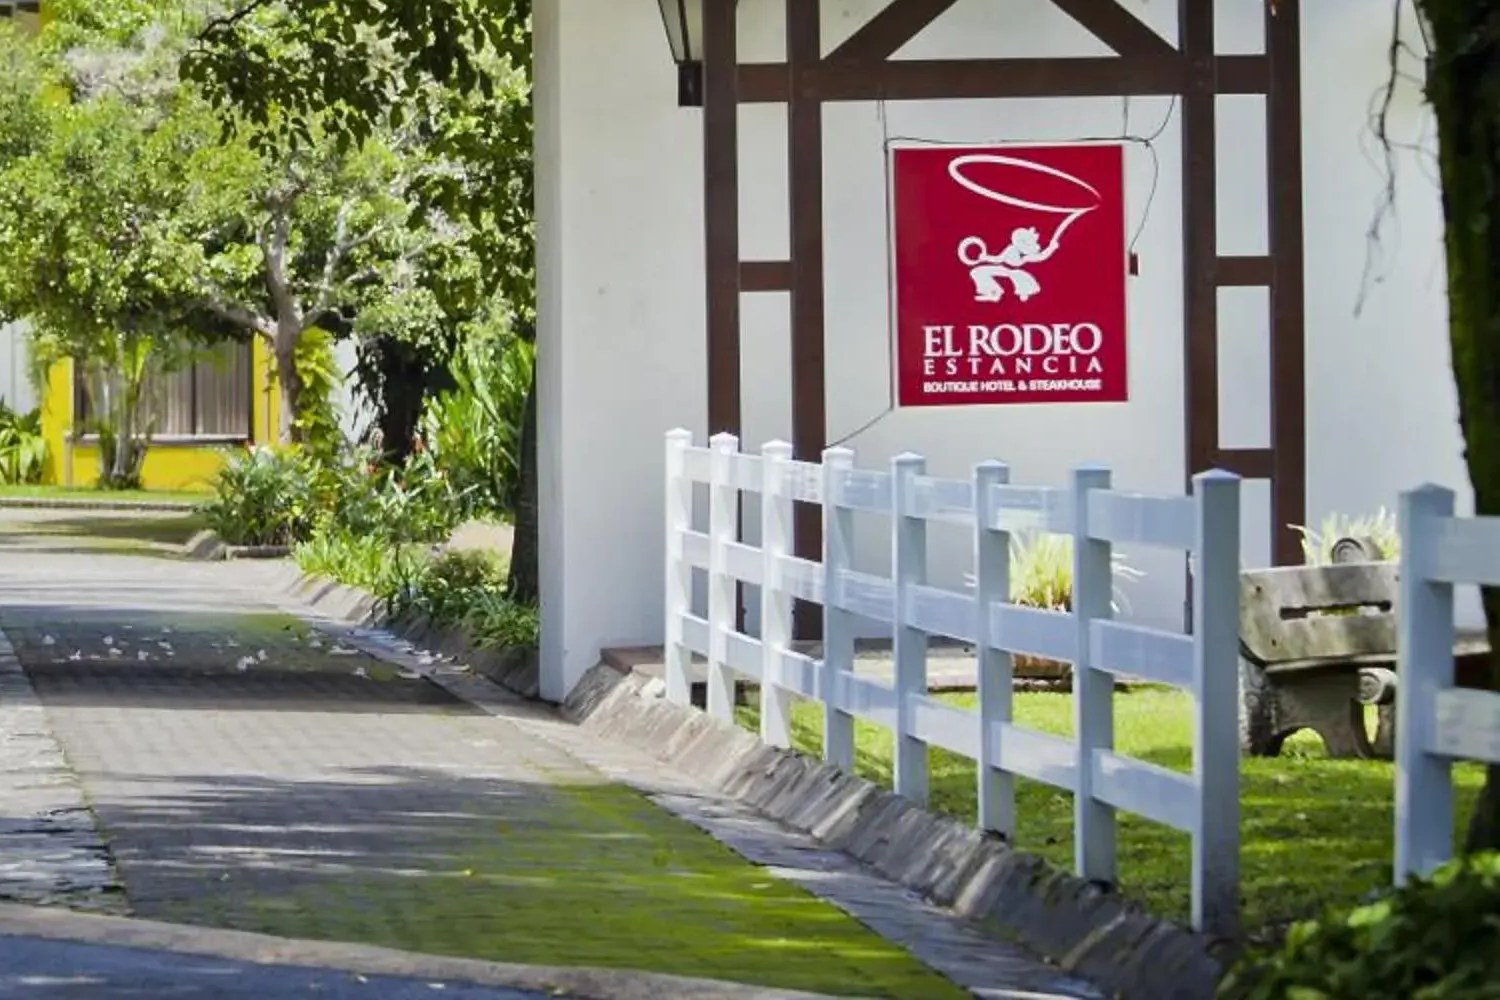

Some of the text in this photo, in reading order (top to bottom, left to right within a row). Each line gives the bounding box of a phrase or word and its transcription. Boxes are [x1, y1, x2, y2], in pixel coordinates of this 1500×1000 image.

[922, 323, 1102, 356] EL RODEO
[924, 356, 1102, 375] ESTANCIA
[923, 381, 978, 392] BOUTIQUE
[981, 380, 1015, 391] HOTEL
[1018, 380, 1027, 391] &
